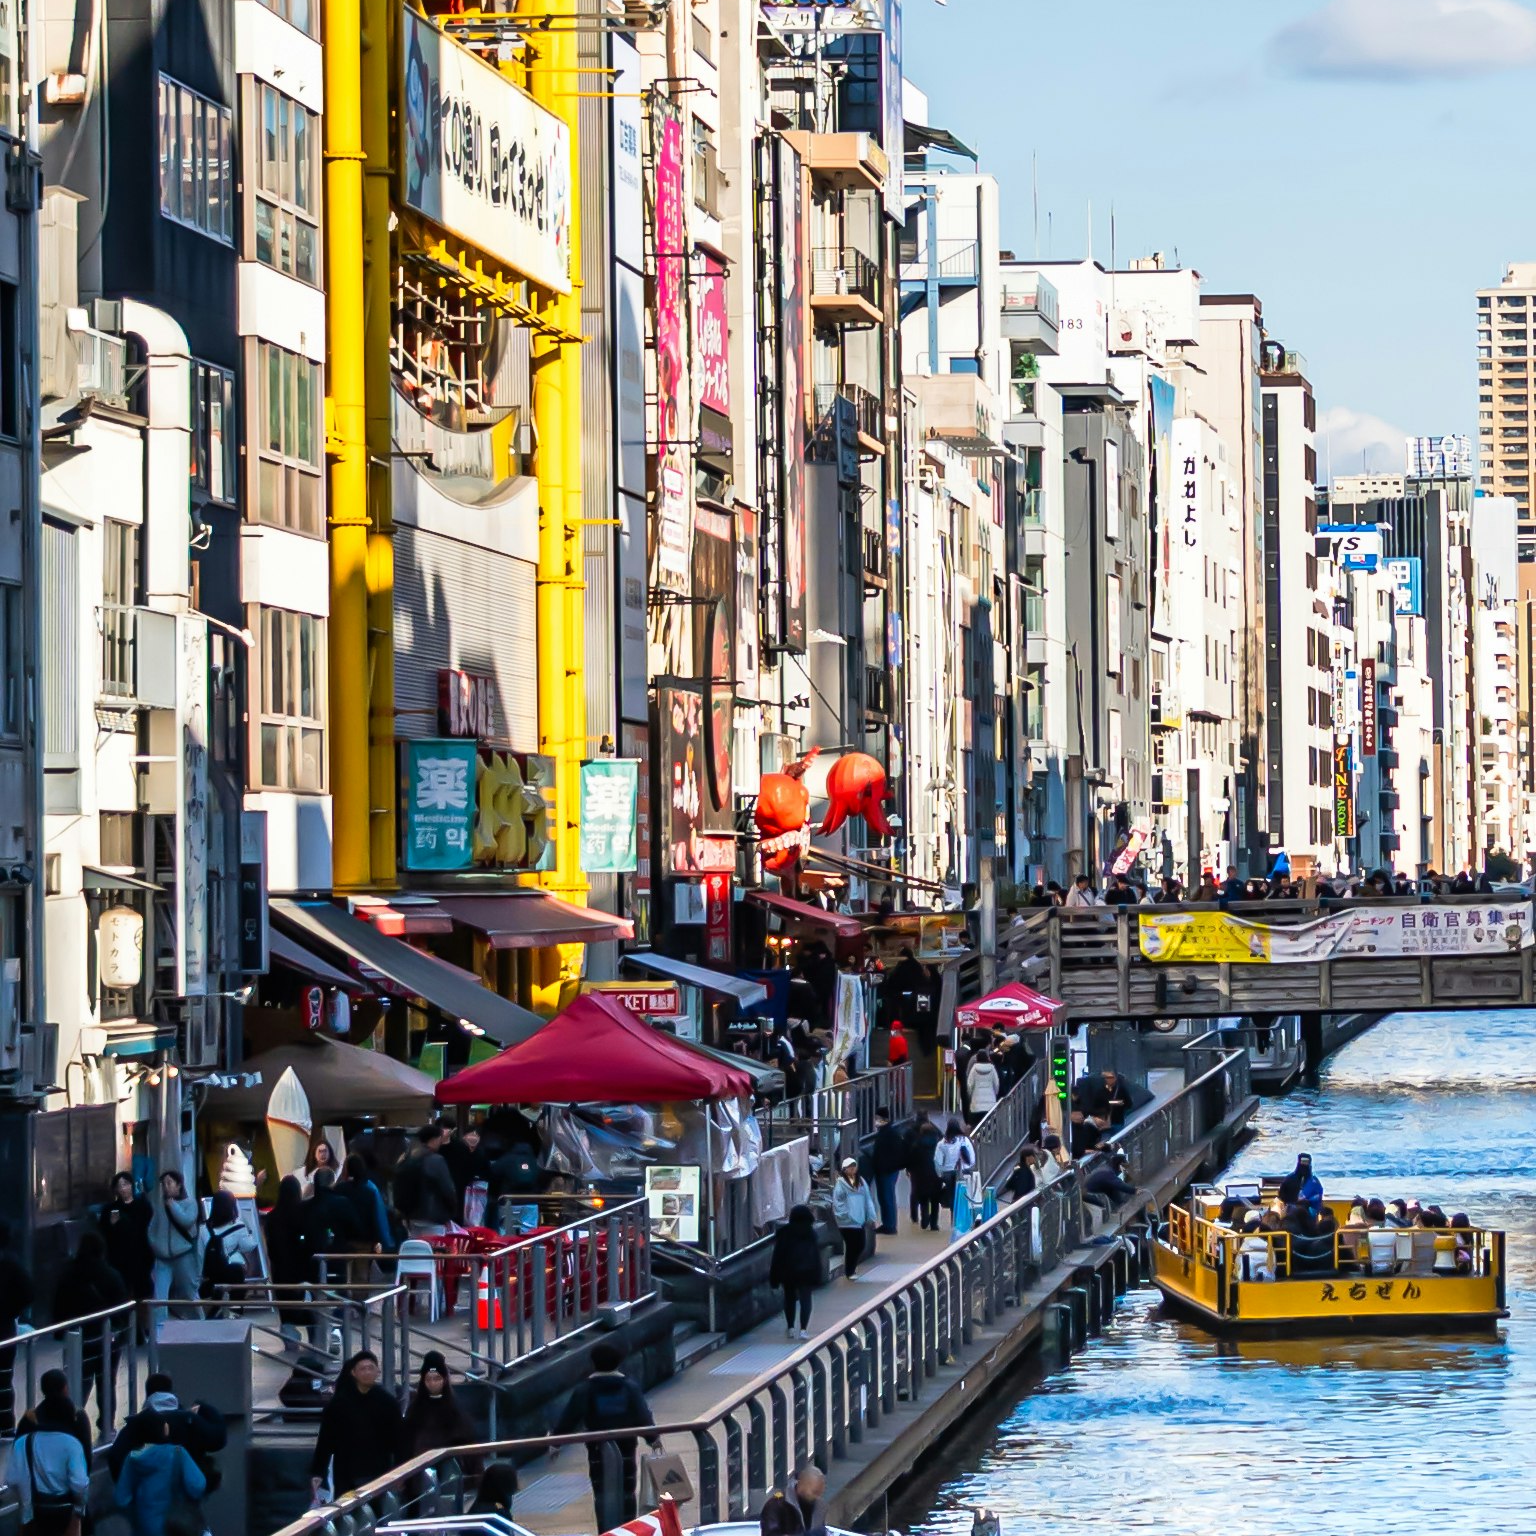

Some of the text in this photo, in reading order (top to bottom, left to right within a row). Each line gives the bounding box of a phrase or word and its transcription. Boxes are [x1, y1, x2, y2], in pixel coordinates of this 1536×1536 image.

[1183, 456, 1197, 547] かねよし
[416, 758, 469, 810] 薬
[1335, 746, 1349, 799] FINE
[586, 774, 633, 821] 薬
[1337, 799, 1346, 836] AROMA
[414, 814, 468, 824] Medicine
[1402, 910, 1526, 928] 自衛官募集中
[1321, 1282, 1421, 1301] えちぜん
